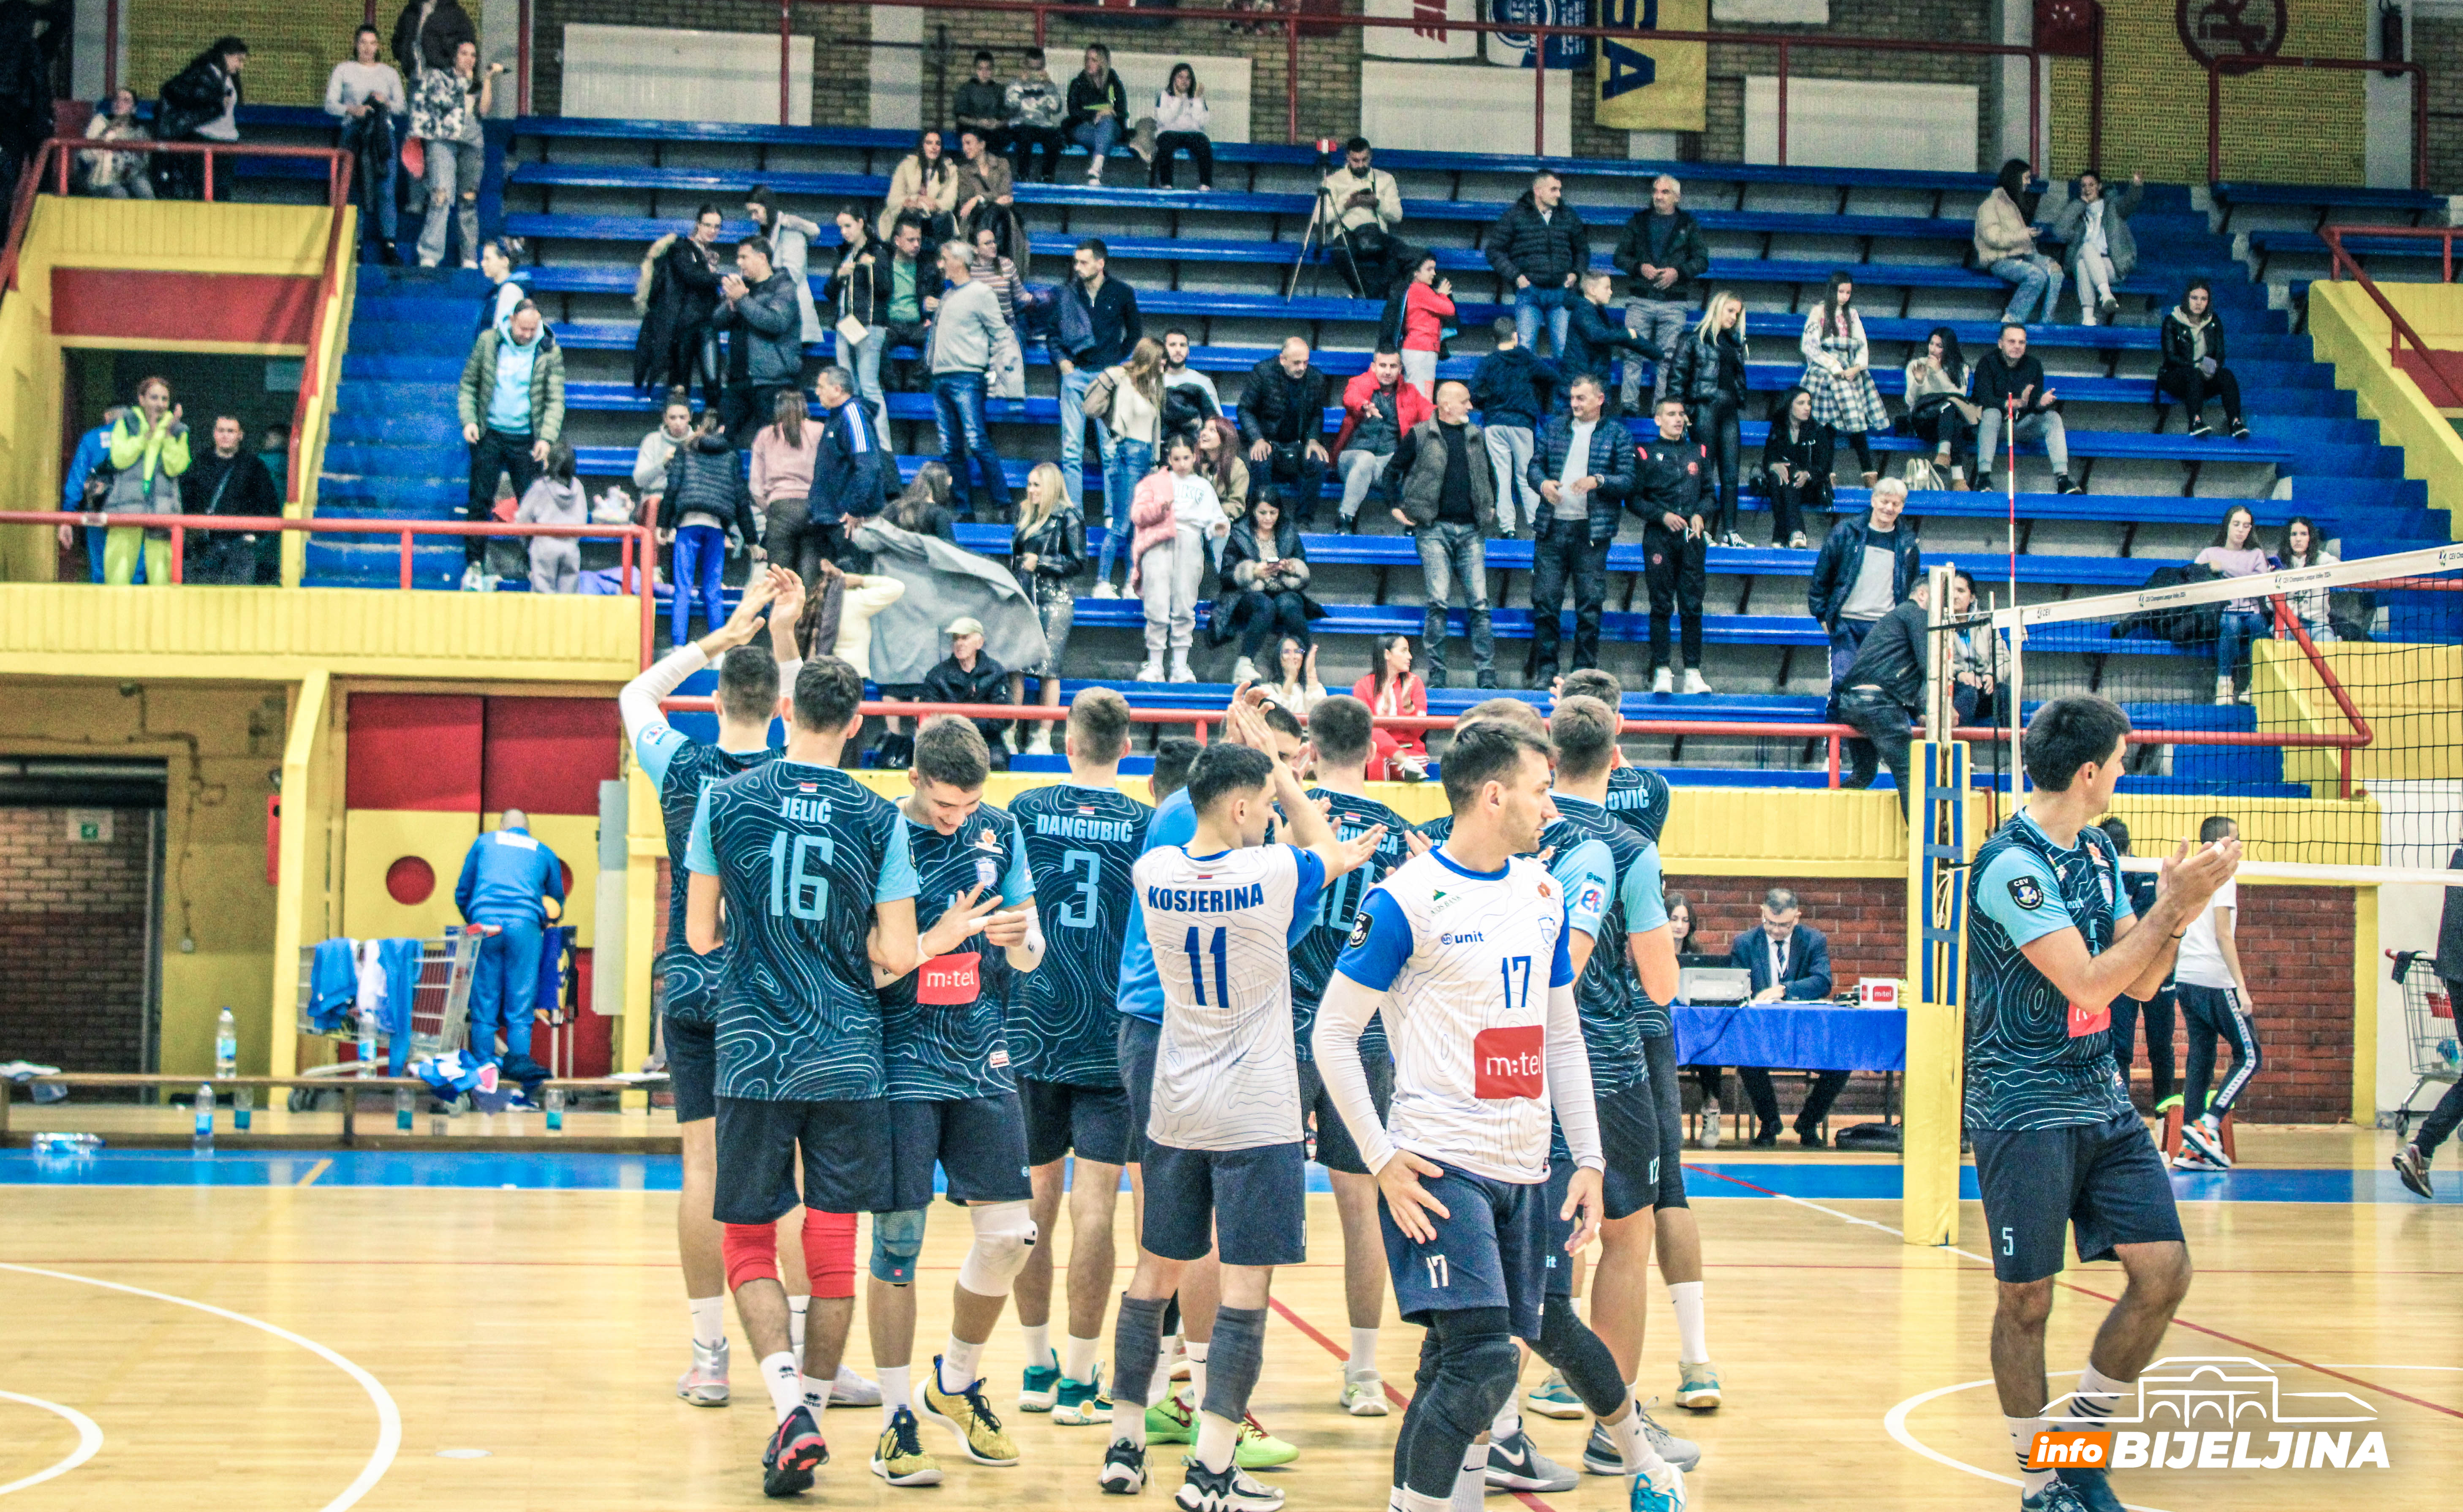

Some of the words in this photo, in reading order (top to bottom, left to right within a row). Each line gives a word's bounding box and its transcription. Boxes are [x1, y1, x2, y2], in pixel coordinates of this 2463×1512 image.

[779, 796, 832, 824] JELIĆ
[1607, 785, 1650, 810] OVIĆ
[1036, 813, 1134, 843] DANGUBIĆ
[769, 830, 834, 921] 16
[1060, 849, 1101, 928] 3
[2014, 878, 2029, 887] CEV
[1148, 883, 1264, 912] KOSJERINA
[1455, 930, 1484, 944] unit
[927, 969, 975, 987] m:tel
[1184, 926, 1229, 1009] 11
[1501, 955, 1531, 1009] 17
[1486, 1046, 1542, 1077] m:tel
[2002, 1227, 2013, 1256] 5
[1426, 1254, 1449, 1289] 17
